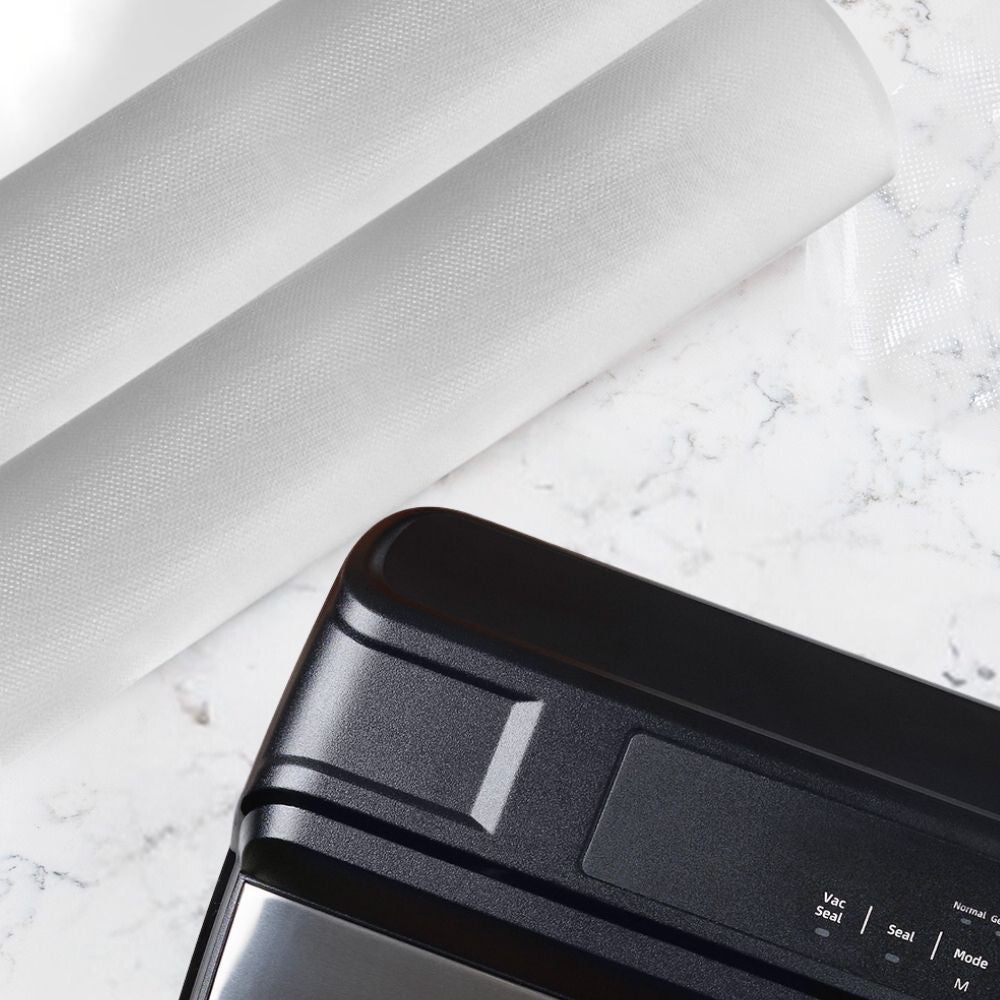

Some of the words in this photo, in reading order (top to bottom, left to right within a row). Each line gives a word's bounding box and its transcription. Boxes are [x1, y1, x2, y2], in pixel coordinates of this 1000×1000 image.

[822, 891, 847, 909] Vac
[814, 905, 843, 924] Seal
[953, 901, 987, 920] Normal
[886, 924, 916, 943] Seal
[953, 948, 989, 970] Mode
